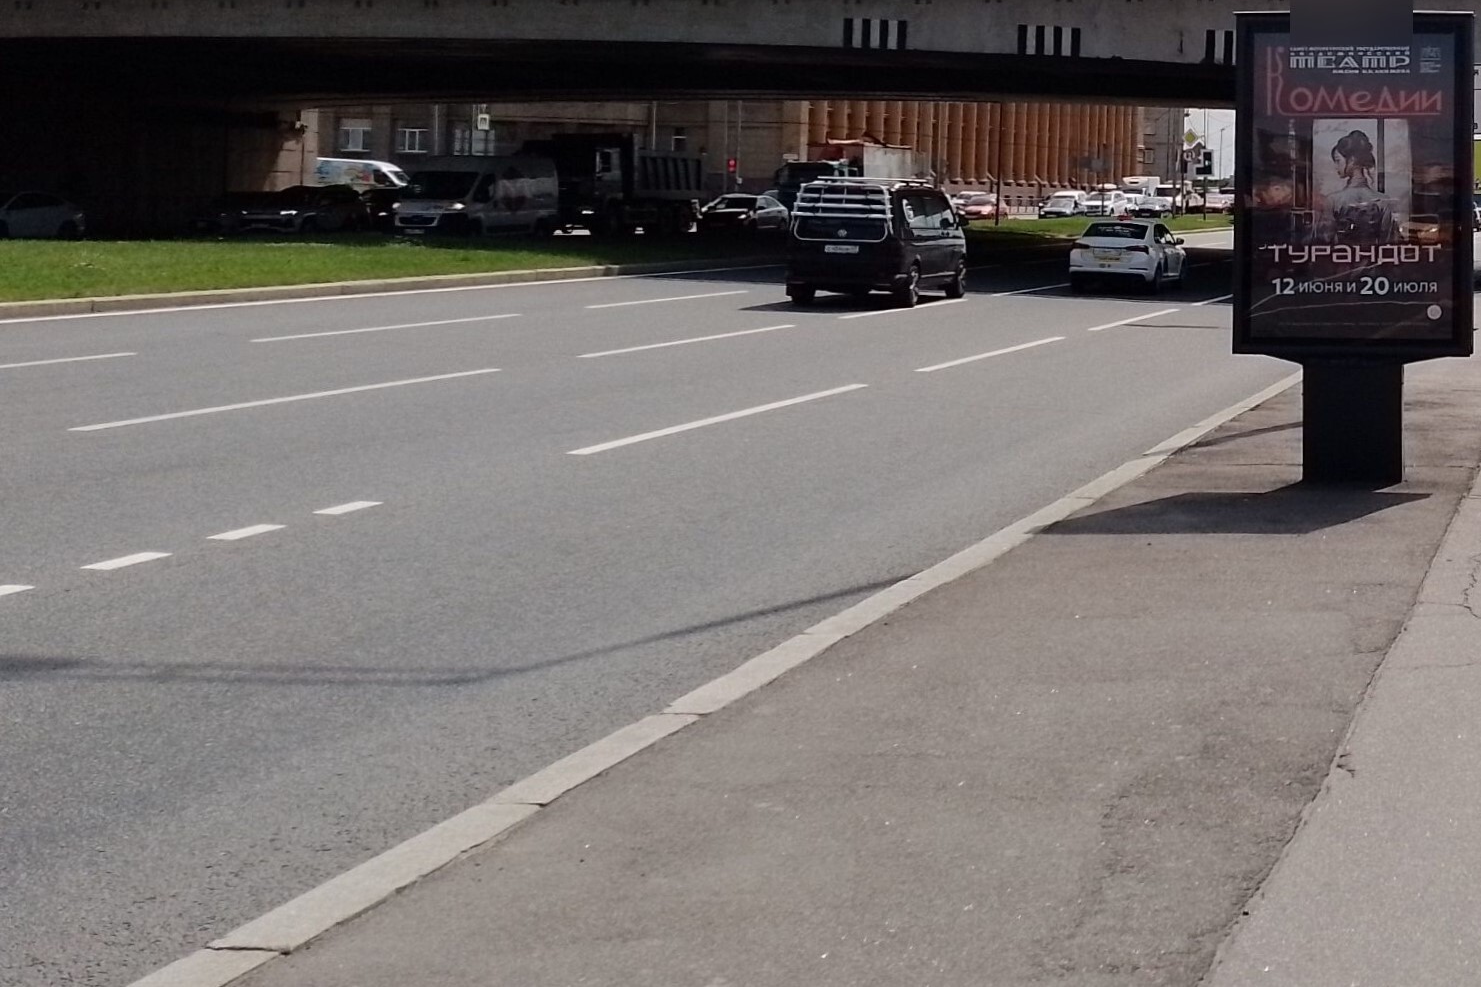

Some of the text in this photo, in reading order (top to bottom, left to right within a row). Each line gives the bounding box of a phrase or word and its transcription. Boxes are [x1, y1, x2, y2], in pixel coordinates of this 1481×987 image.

[1271, 276, 1438, 296] 12 июня и 20 июля
